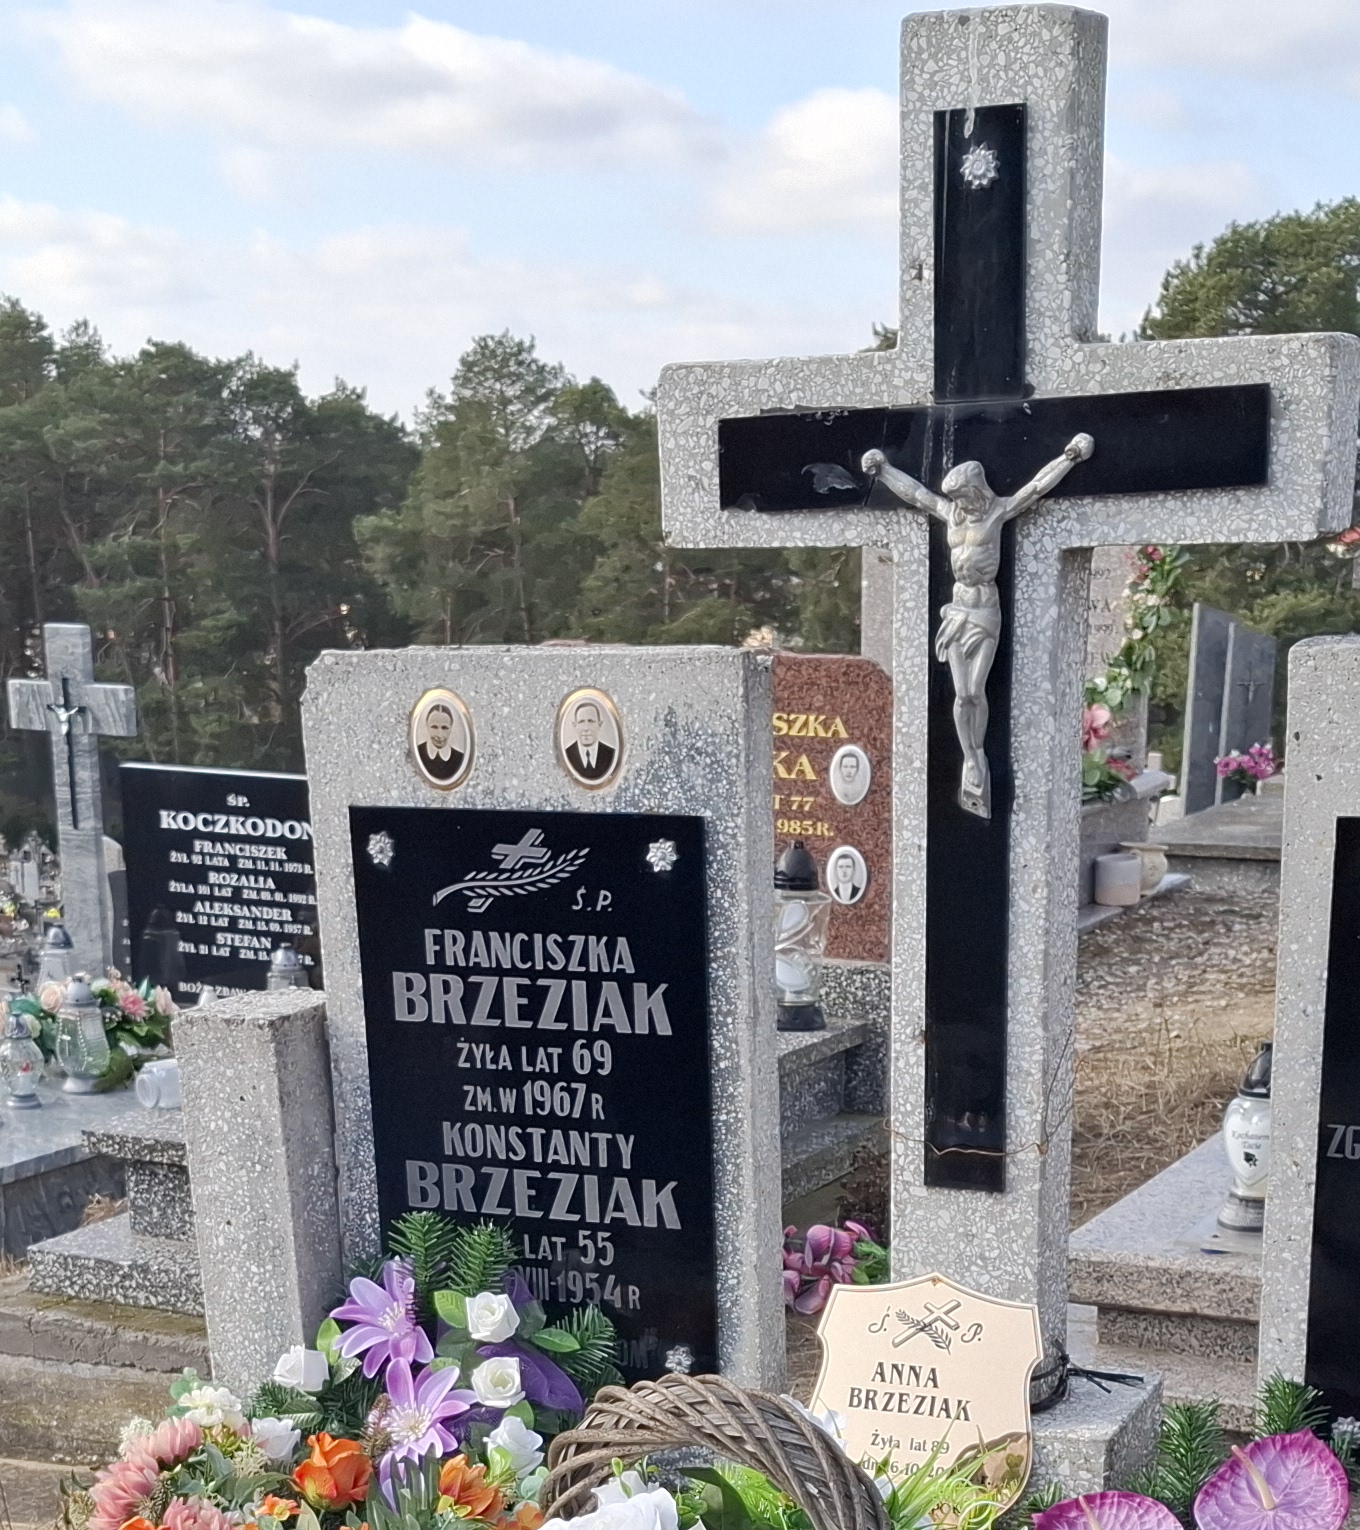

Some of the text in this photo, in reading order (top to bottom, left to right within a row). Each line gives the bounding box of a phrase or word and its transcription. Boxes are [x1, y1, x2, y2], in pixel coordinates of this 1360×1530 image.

[772, 713, 849, 738] SZKA
[193, 839, 288, 860] FRANCISZEK
[205, 854, 230, 867] LATA
[208, 870, 276, 889] ROZALIA
[213, 886, 233, 897] LAT
[193, 900, 293, 922] ALEKSANDER
[210, 915, 230, 927] LAT
[211, 945, 231, 957] LAT
[215, 931, 272, 949] STEFAN
[424, 929, 635, 973] FRANCISZKA
[392, 971, 672, 1035] BRZEZIAK
[457, 1037, 612, 1076] ŻYŁA LAT 69
[523, 1080, 586, 1118] 1967
[591, 1093, 605, 1120] R
[442, 1121, 634, 1169] KONSTANTY
[405, 1159, 682, 1230] BRZEZIAK
[523, 1229, 615, 1266] LAT 55
[628, 1285, 640, 1310] R
[871, 1361, 940, 1389] ANNA
[847, 1386, 972, 1422] BRZEZIAK
[870, 1429, 950, 1454] Żyła lat 89
